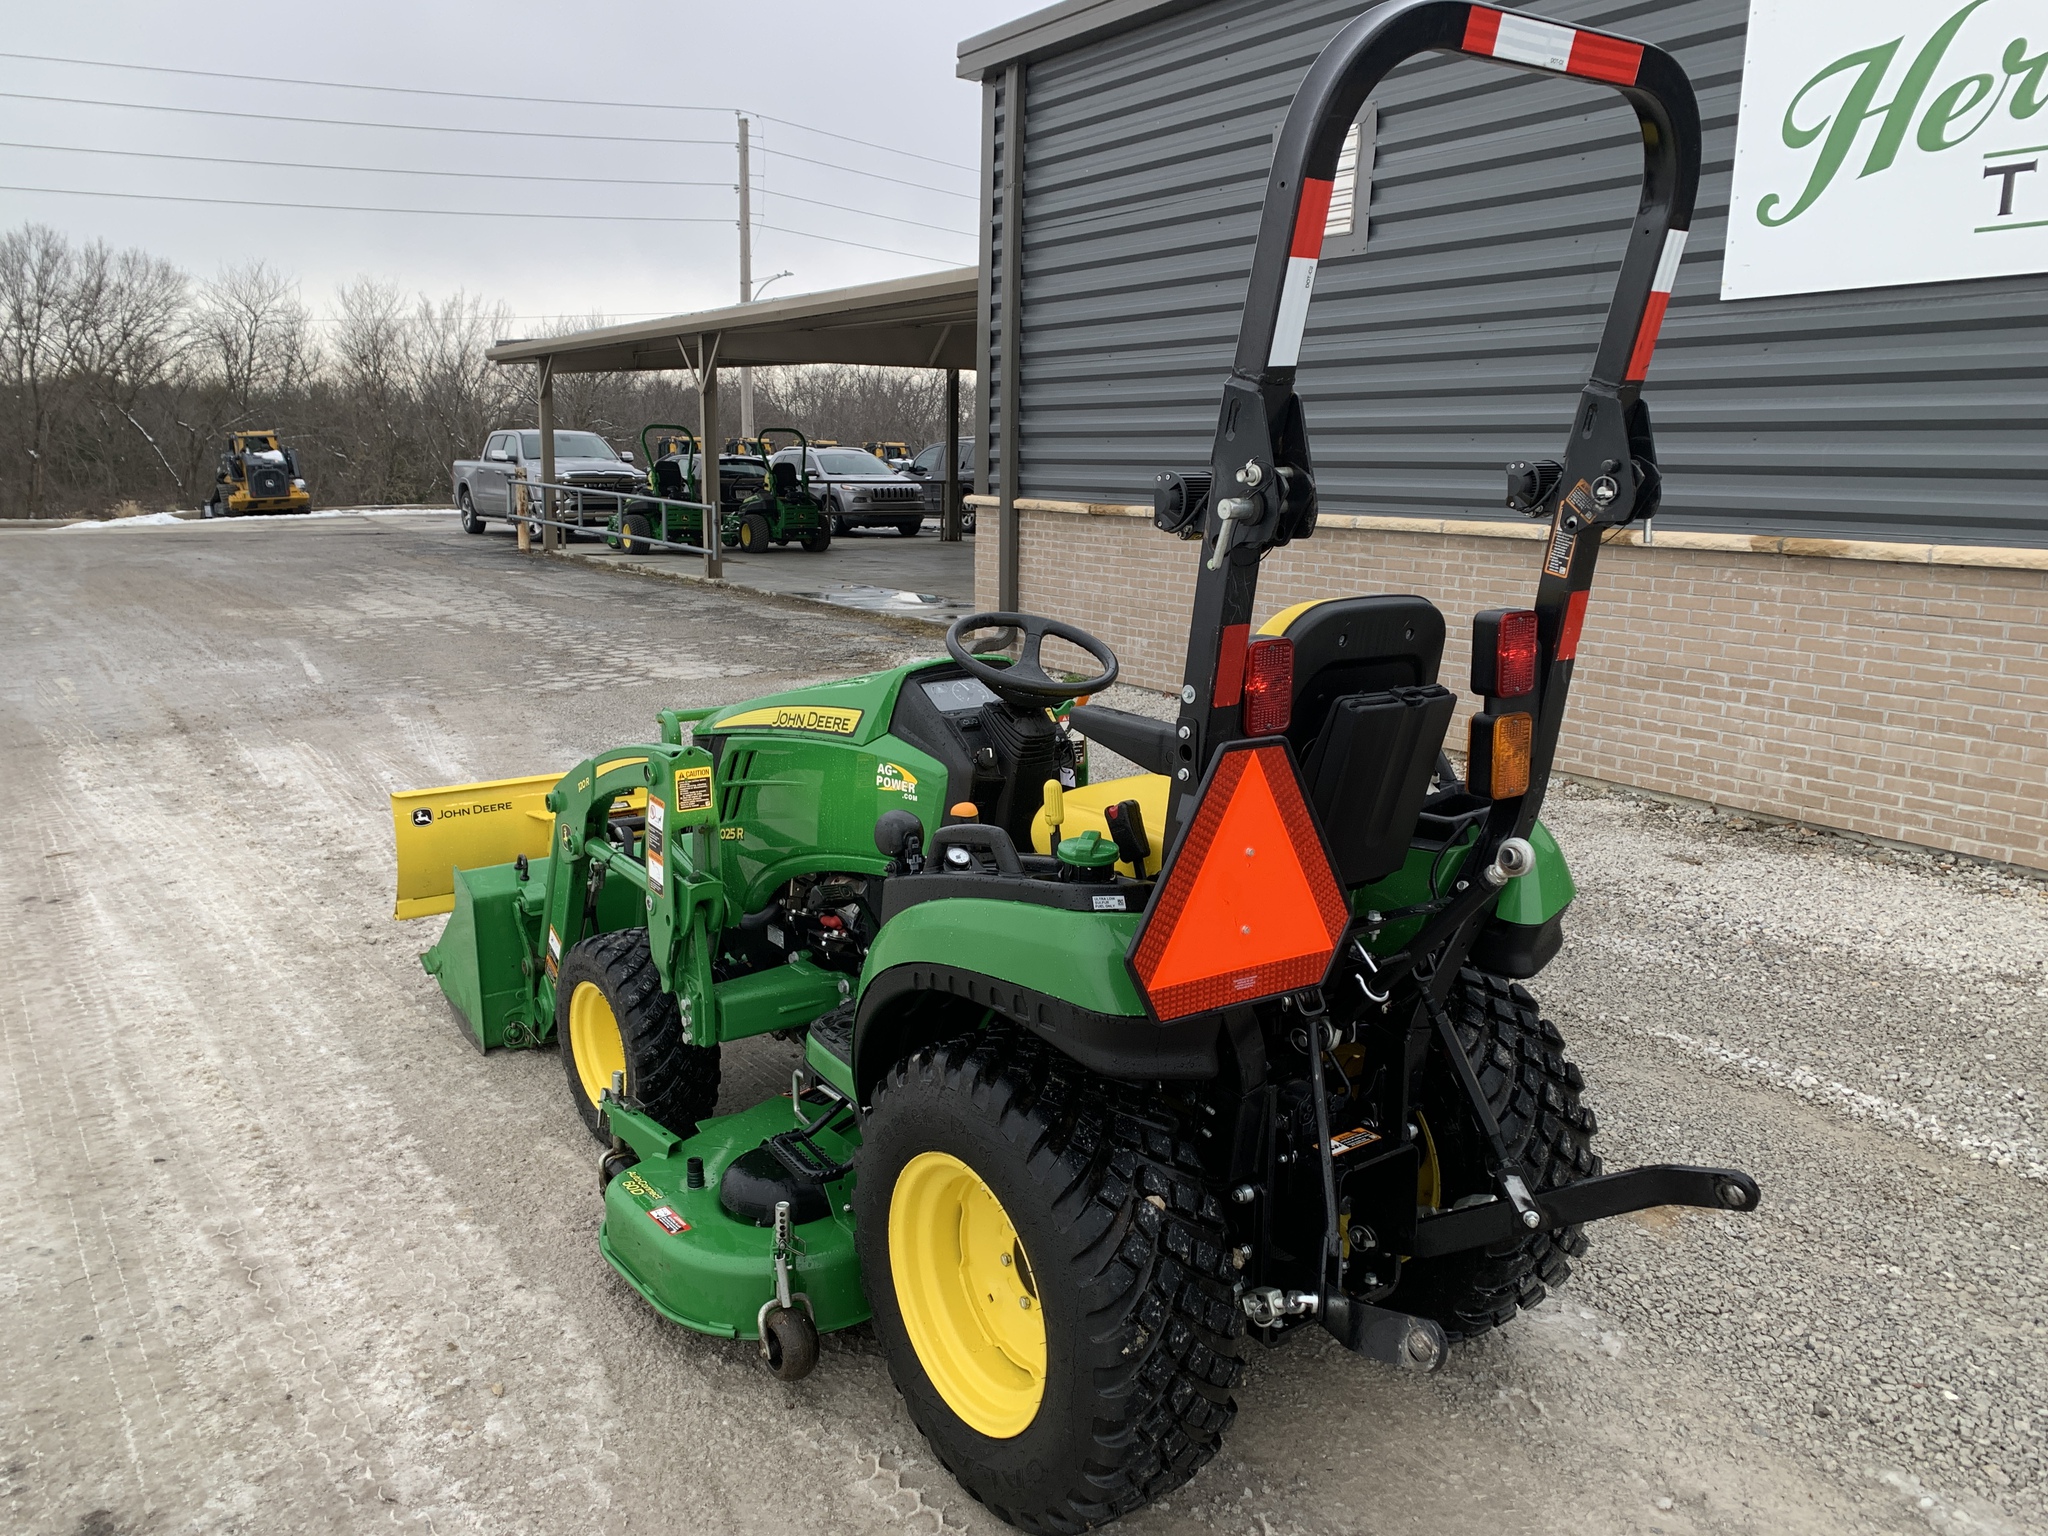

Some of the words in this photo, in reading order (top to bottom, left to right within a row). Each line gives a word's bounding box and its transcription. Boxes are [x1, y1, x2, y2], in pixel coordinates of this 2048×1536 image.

[1983, 159, 2038, 215] T
[772, 710, 805, 726] JOHN
[807, 712, 851, 731] DEERE
[686, 769, 710, 778] CAUTION
[876, 775, 916, 794] POWER
[901, 793, 918, 802] .COM
[437, 808, 471, 820] JOHN
[473, 802, 513, 814] DEERE
[622, 1180, 645, 1195] 60D
